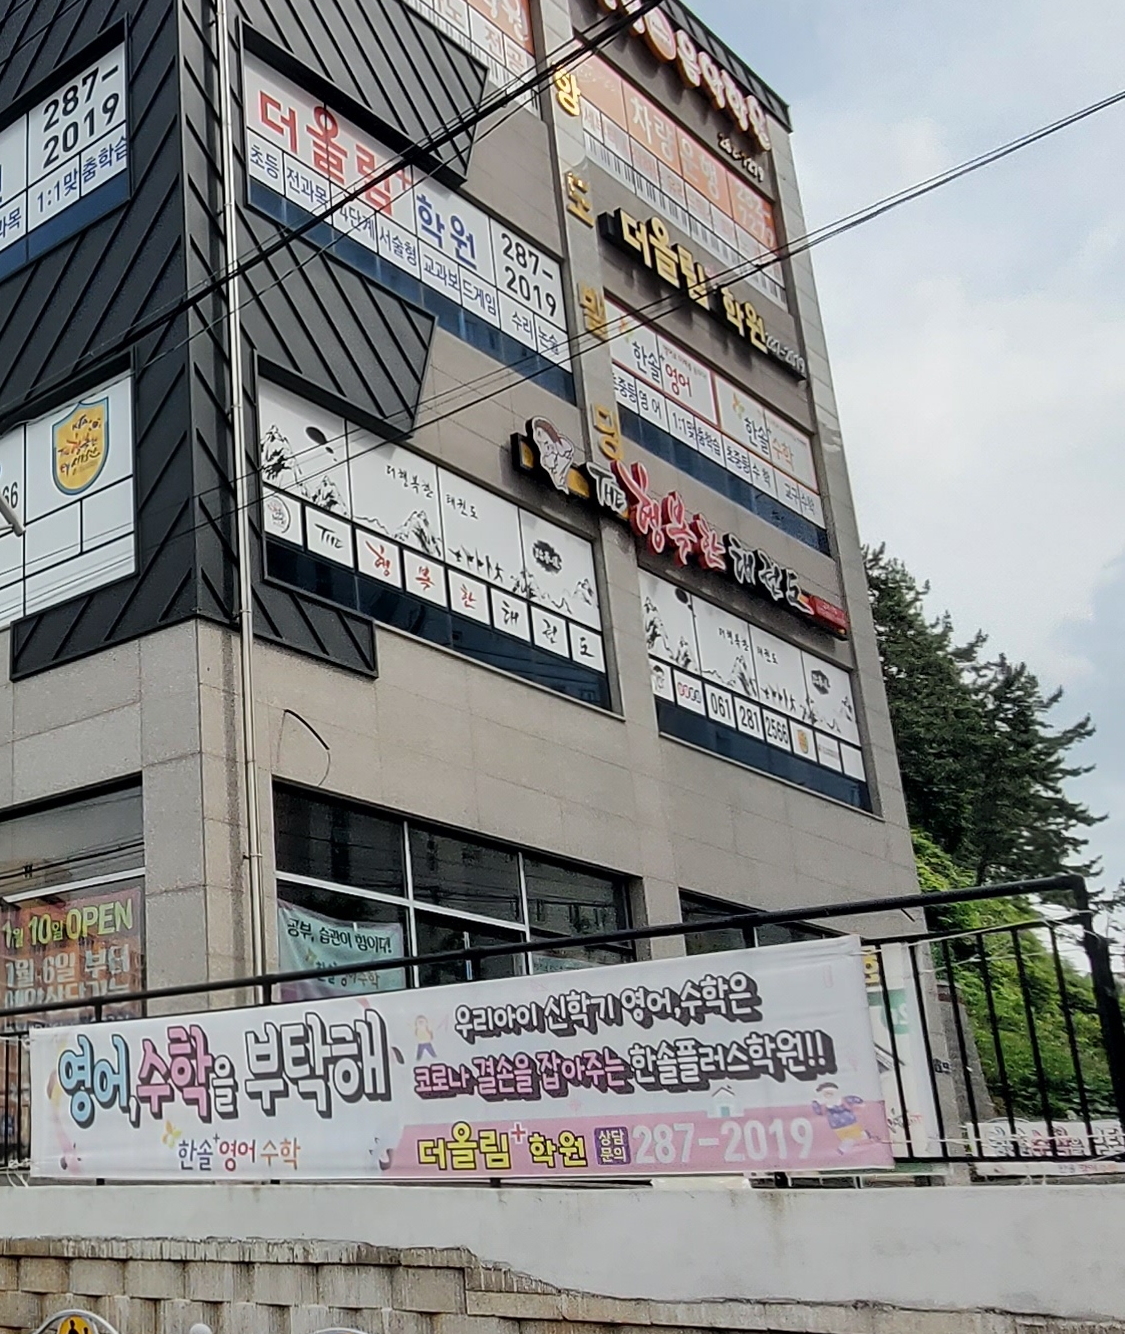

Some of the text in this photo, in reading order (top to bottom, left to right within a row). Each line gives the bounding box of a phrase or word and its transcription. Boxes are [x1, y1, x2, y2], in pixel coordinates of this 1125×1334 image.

[43, 66, 119, 132] 287-
[43, 93, 119, 170] 2019
[249, 145, 280, 179] 초등
[286, 168, 328, 208] 전과목
[379, 230, 418, 267] 서술형
[416, 193, 478, 271] 학원
[501, 232, 555, 281] 287-
[505, 265, 557, 317] 2019
[720, 285, 768, 355] 학원
[588, 463, 627, 514] THE
[613, 458, 727, 570] 행복한
[726, 543, 816, 617] 태권도
[709, 693, 732, 719] 061
[739, 705, 761, 733] 281
[66, 898, 133, 941] OPEN
[319, 926, 352, 949] 습관이
[454, 999, 539, 1037] 우리아이
[544, 989, 616, 1033] 신학기
[244, 1009, 392, 1119] 부탁해
[413, 1060, 473, 1096] 코로나
[473, 1053, 534, 1095] 결손을
[536, 1046, 627, 1092] 잡아주는
[260, 1137, 301, 1171] 수학
[528, 1129, 589, 1168] 학원
[598, 1127, 626, 1147] 상담
[598, 1146, 627, 1165] 문의
[631, 1117, 815, 1166] 287-2019
